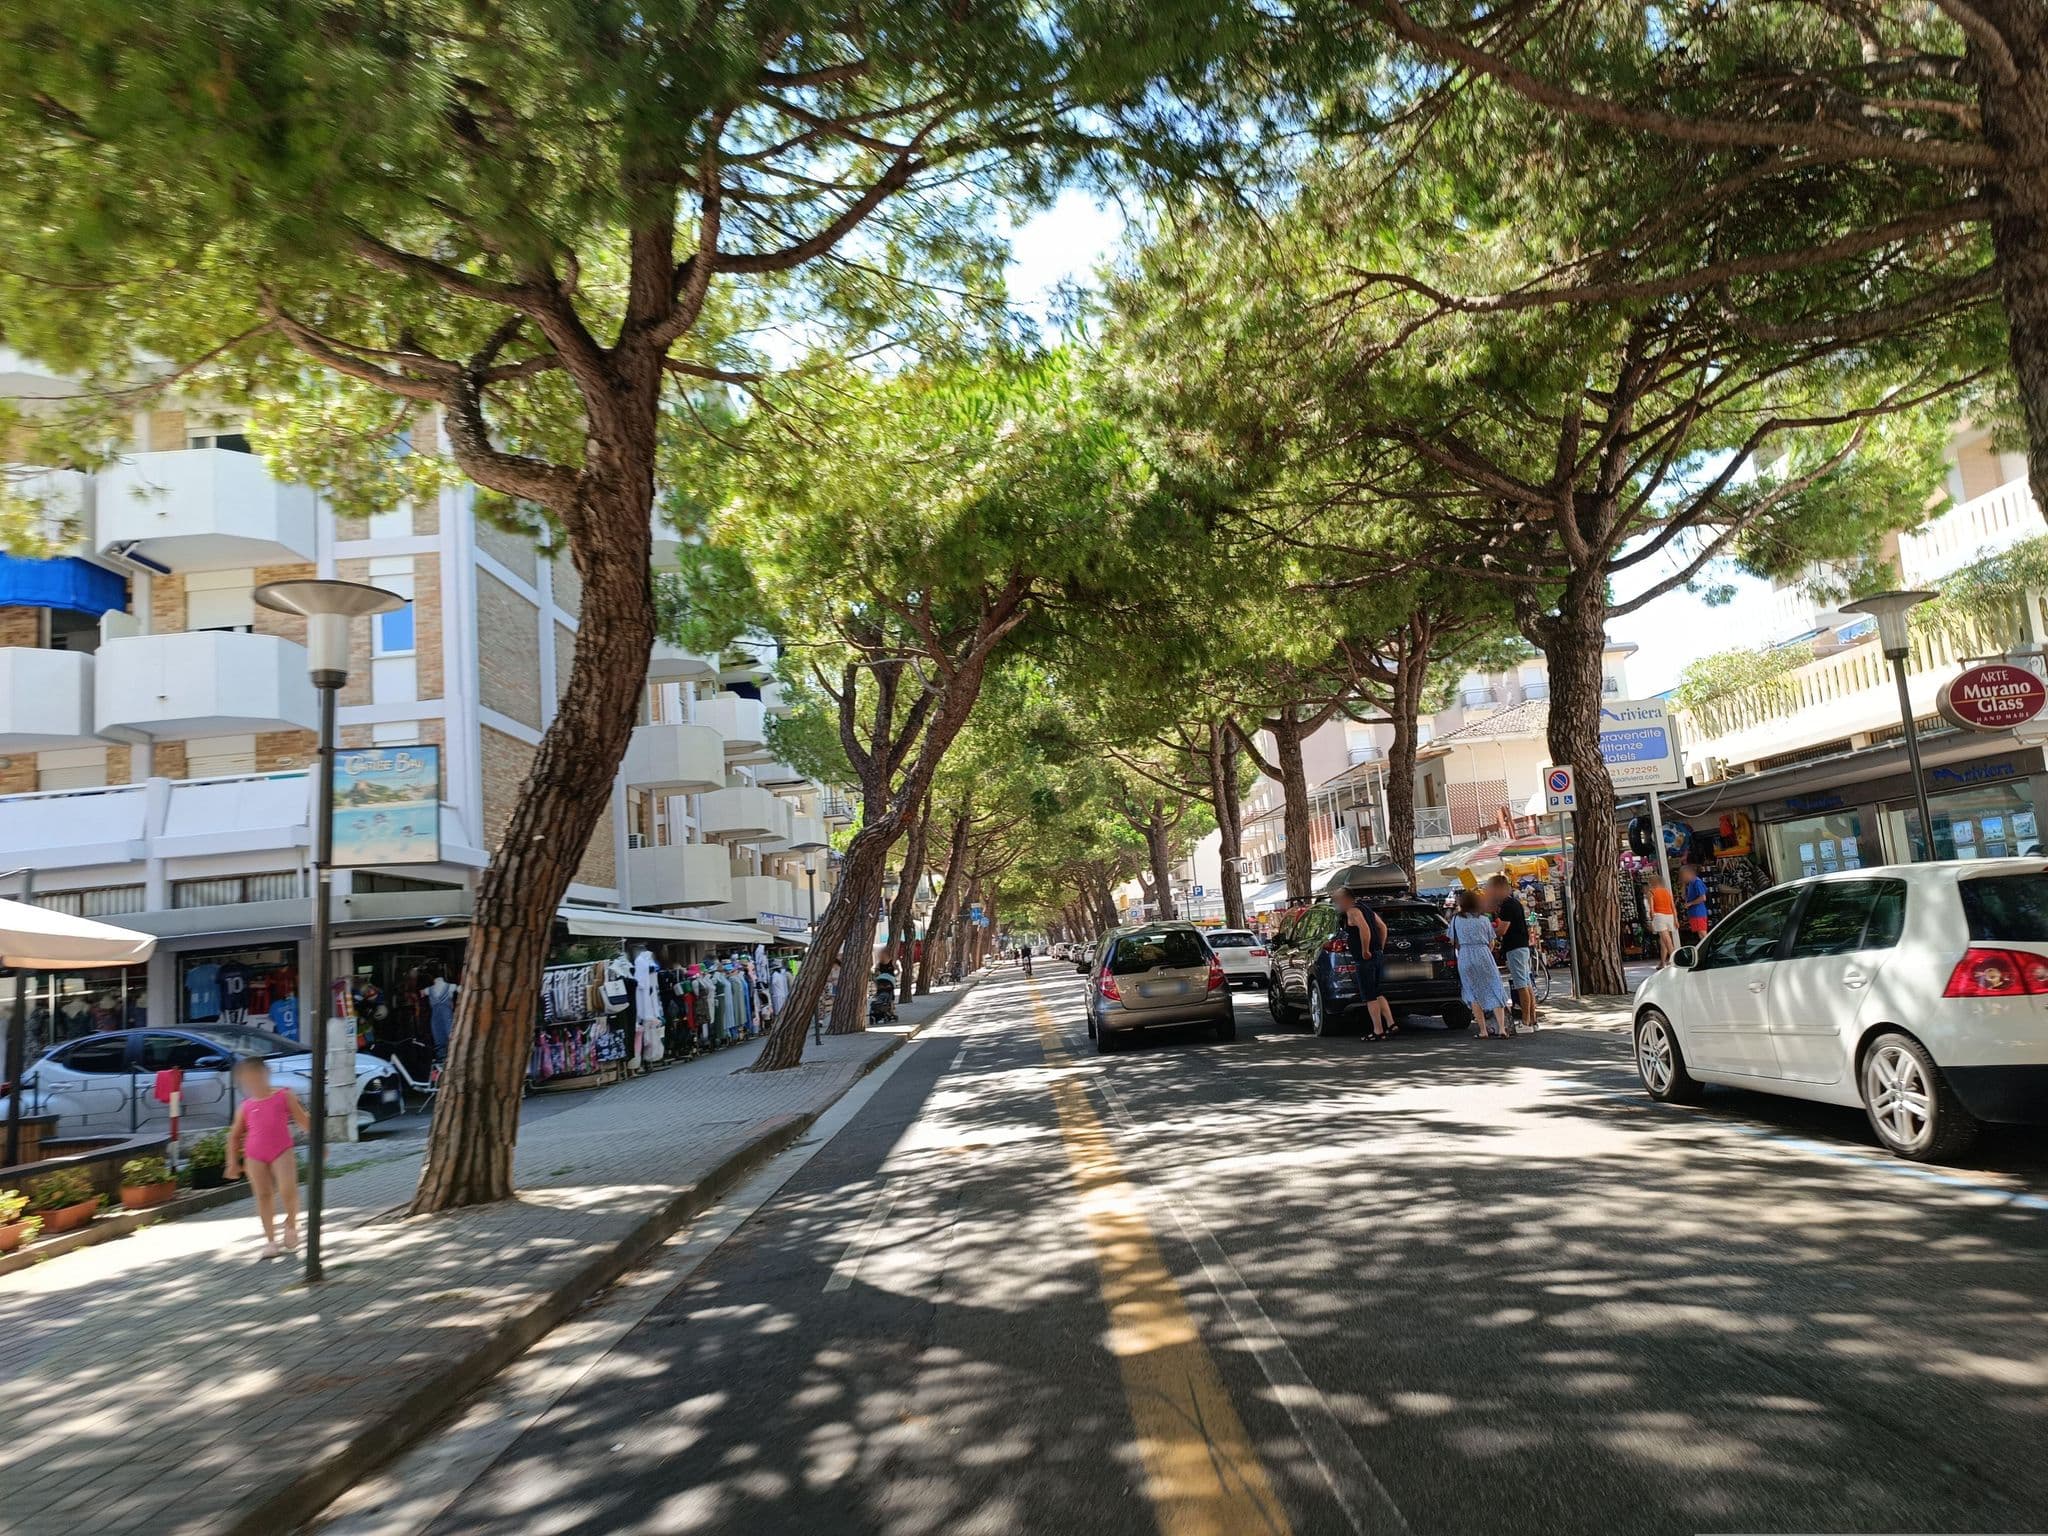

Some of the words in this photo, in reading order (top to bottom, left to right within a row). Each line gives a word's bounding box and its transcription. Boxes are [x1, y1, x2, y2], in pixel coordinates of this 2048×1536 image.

[1980, 670, 2009, 683] ARTE
[1964, 682, 2031, 700] Murano
[1977, 697, 2024, 713] Glass
[1619, 707, 1662, 721] riviera
[1976, 715, 2001, 723] HAND
[2005, 712, 2029, 720] MADE
[1600, 729, 1661, 743] pravendite
[225, 976, 244, 995] 10
[283, 1010, 294, 1027] 9
